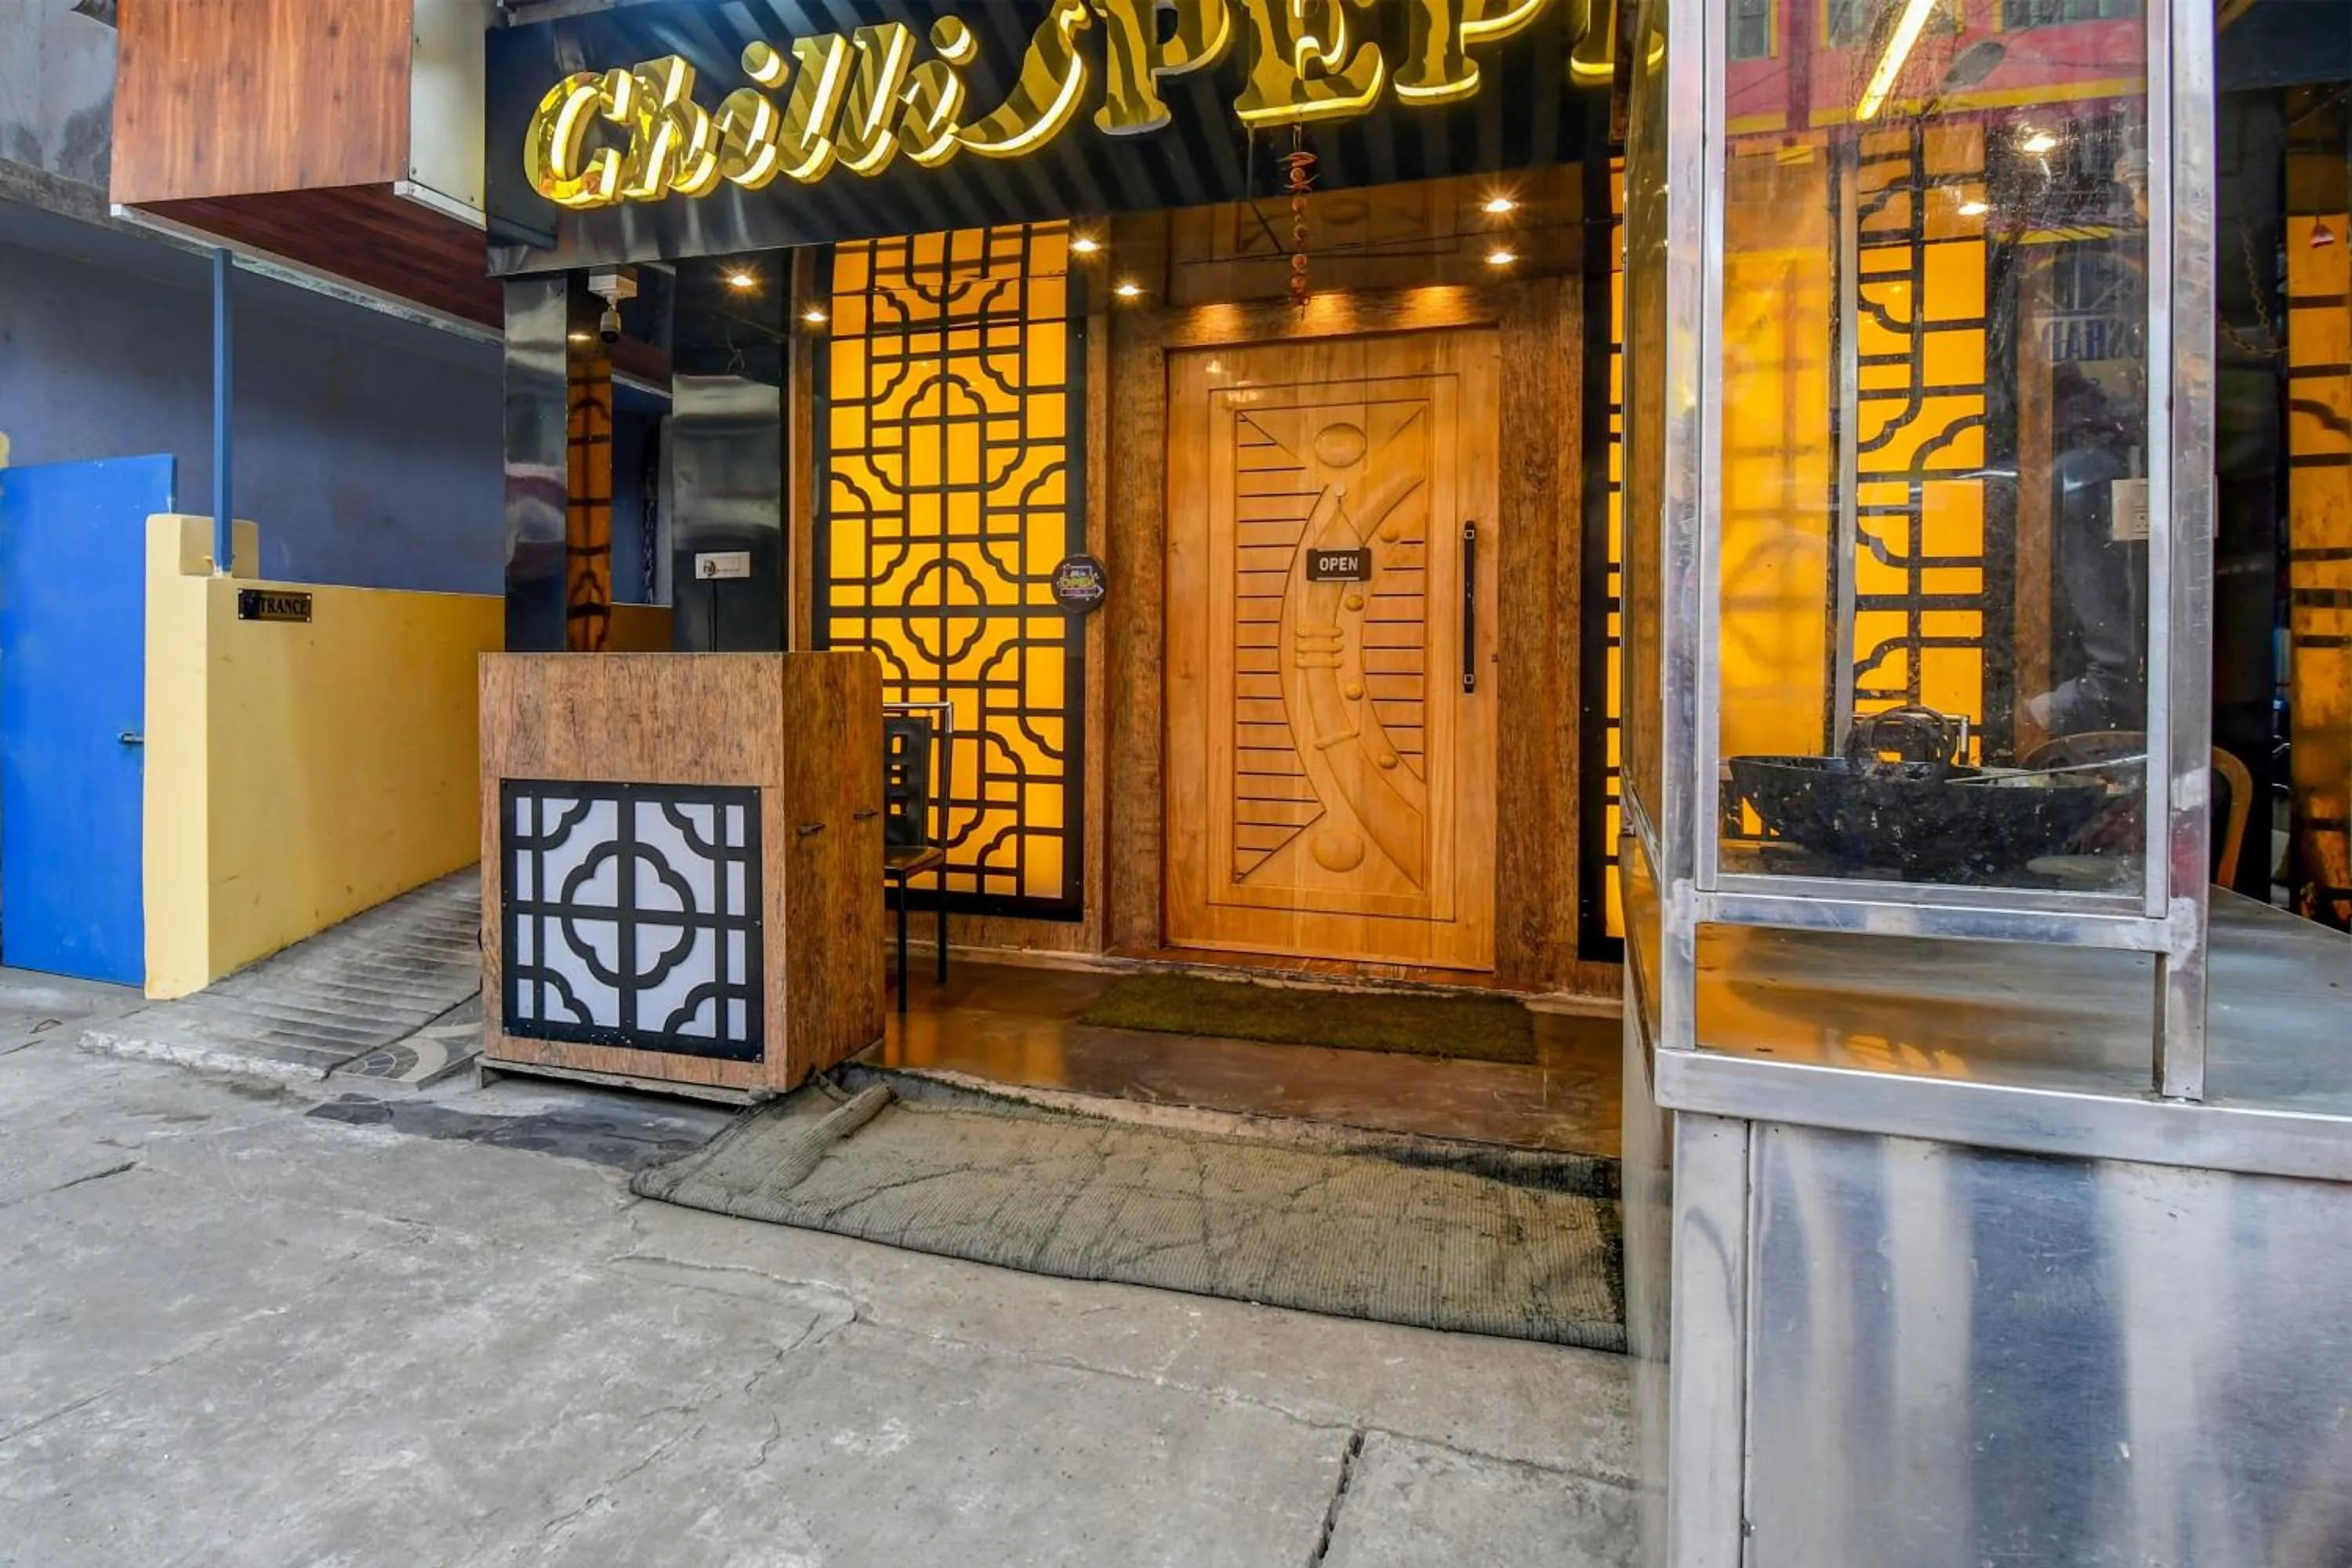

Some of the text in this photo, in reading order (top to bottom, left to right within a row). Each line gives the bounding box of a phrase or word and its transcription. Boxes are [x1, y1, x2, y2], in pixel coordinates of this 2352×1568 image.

[524, 16, 977, 209] Chilli
[1319, 557, 1359, 572] OPEN
[245, 597, 307, 615] TRANCE
